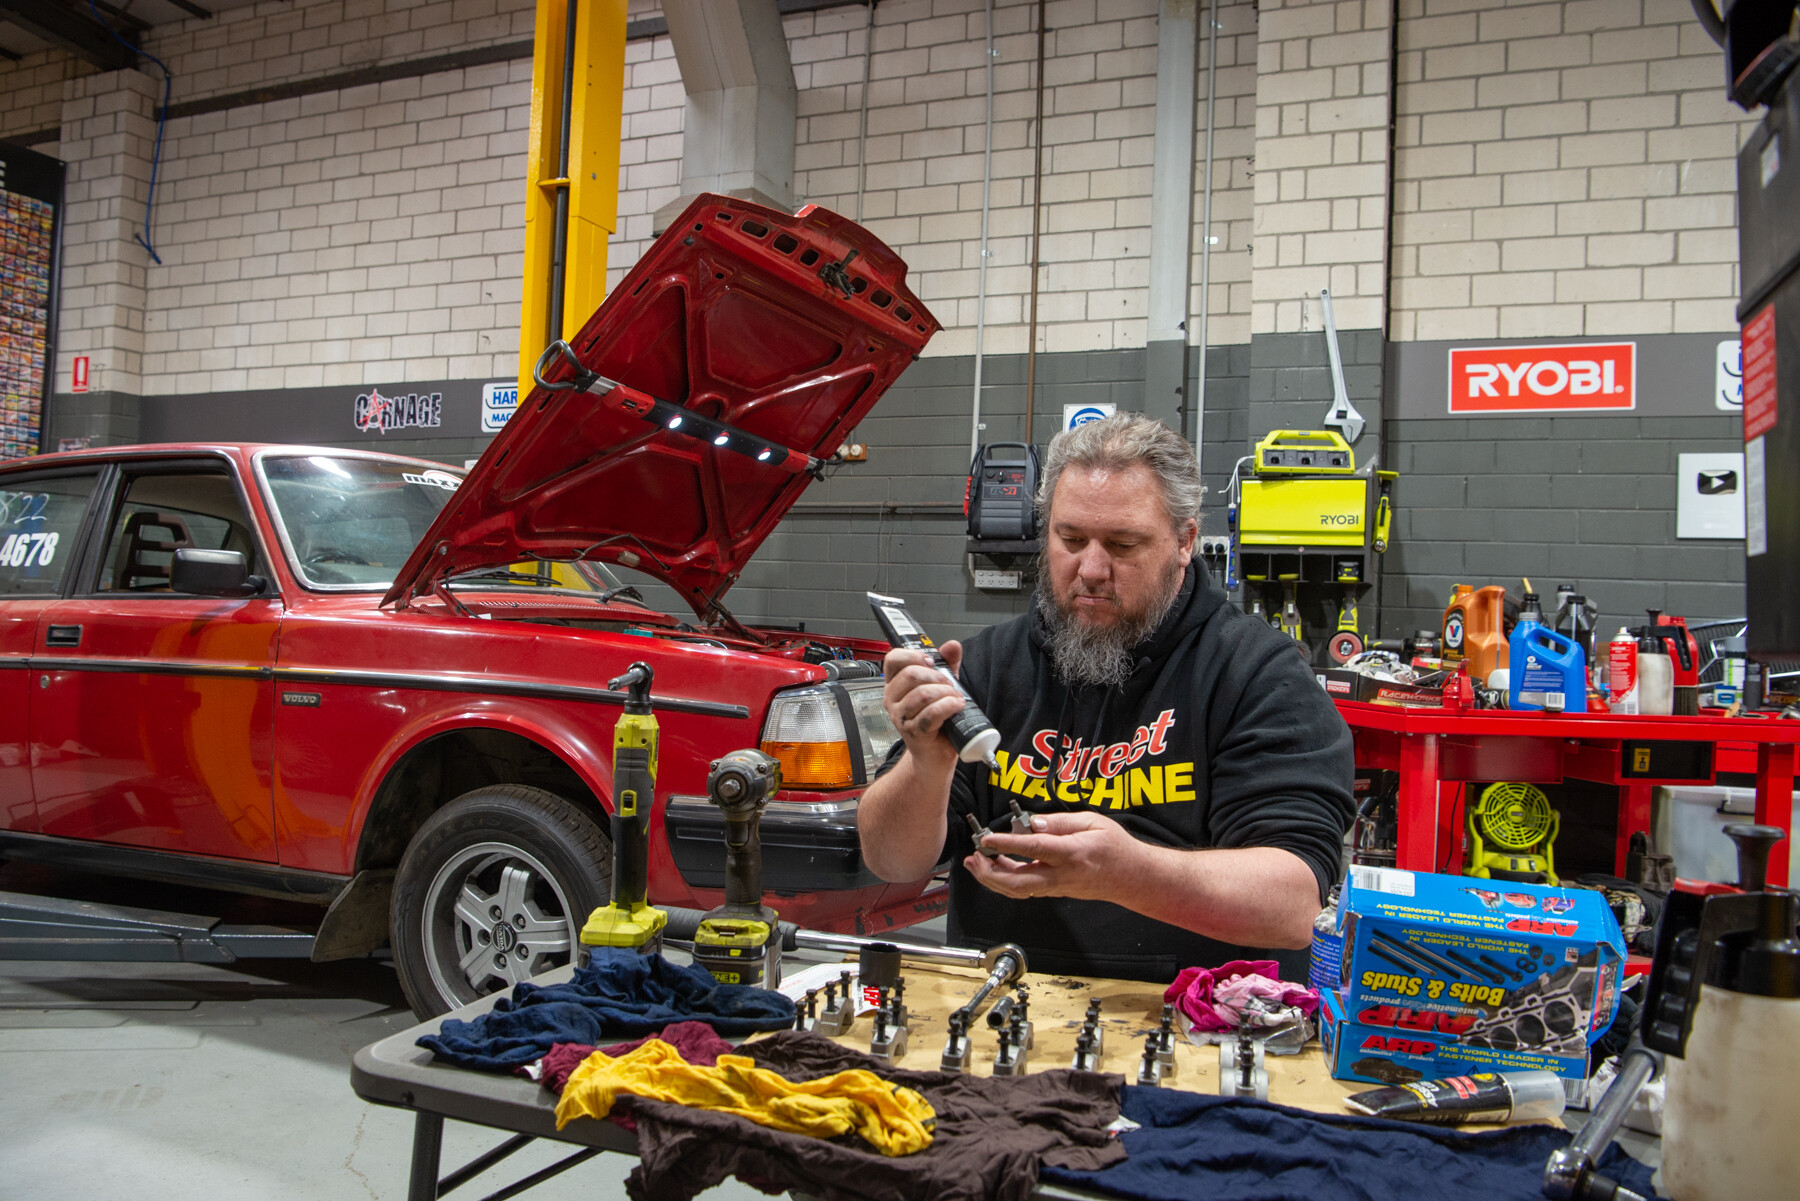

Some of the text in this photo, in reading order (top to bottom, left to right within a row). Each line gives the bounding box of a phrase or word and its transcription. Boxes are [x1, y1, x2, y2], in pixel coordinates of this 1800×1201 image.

[1466, 360, 1615, 398] RYOBI
[1320, 515, 1359, 525] RYOBI
[283, 694, 317, 704] VOLVO
[1018, 708, 1176, 783] Street
[987, 749, 1197, 810] MACHINE
[1376, 903, 1505, 923] FASTENER TECHNOLOGY
[1399, 912, 1440, 922] LEADER
[1443, 917, 1481, 927] WORLD
[1484, 922, 1505, 930] THE
[1506, 918, 1579, 938] ARP
[1402, 929, 1529, 949] FASTENER TECHNOLOGY
[1424, 937, 1464, 947] LEADER
[1467, 942, 1505, 952] WORLD
[1508, 947, 1528, 955] THE
[1361, 970, 1506, 1007] Bolts & Studs
[1357, 1004, 1478, 1036] ARP
[1360, 1034, 1436, 1056] ARP
[1440, 1045, 1459, 1053] THE
[1463, 1048, 1500, 1058] WORLD
[1503, 1053, 1545, 1063] LEADER
[1438, 1052, 1493, 1063] FASTENER
[1496, 1059, 1567, 1072] TECHNOLOGY
